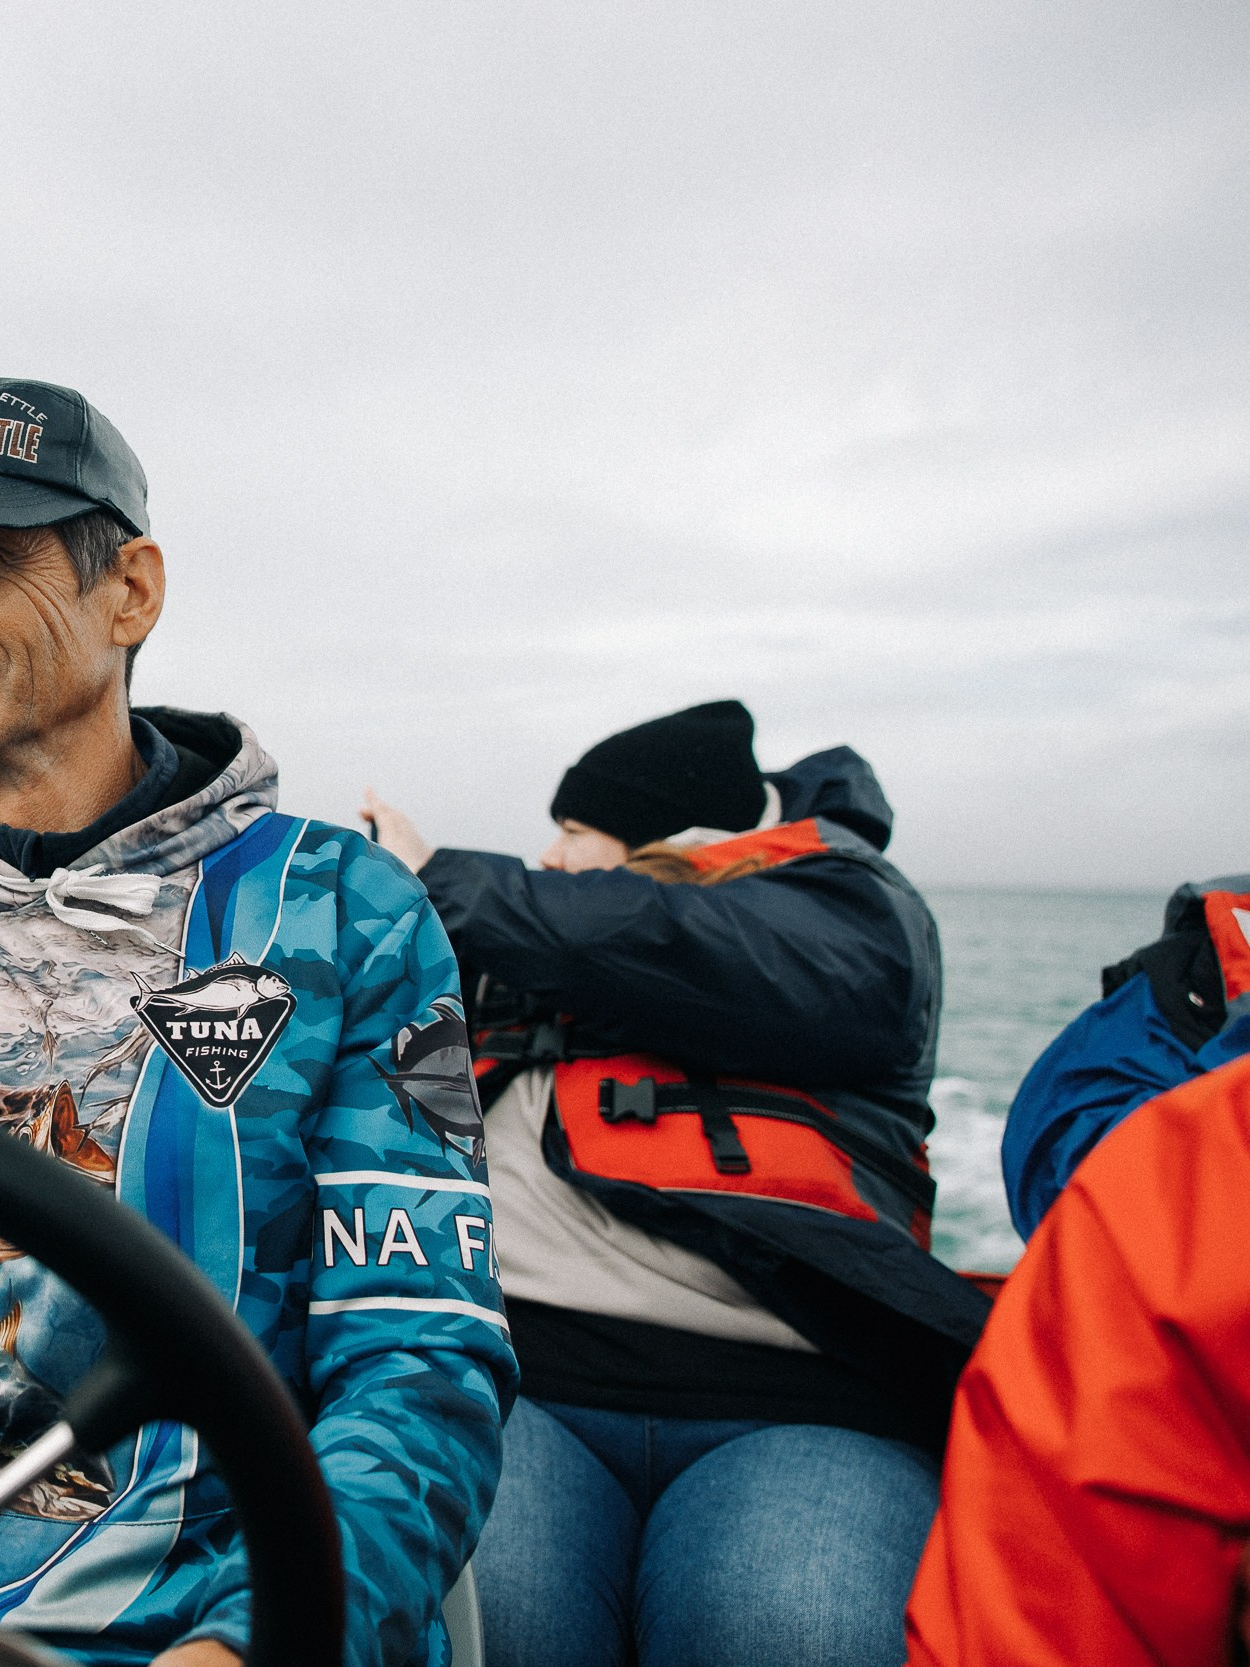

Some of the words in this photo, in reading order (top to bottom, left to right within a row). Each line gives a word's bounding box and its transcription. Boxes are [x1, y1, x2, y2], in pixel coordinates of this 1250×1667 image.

[165, 1017, 264, 1041] TUNA
[185, 1045, 249, 1059] FISHING
[321, 1206, 431, 1268] NA
[453, 1213, 502, 1287] FI
